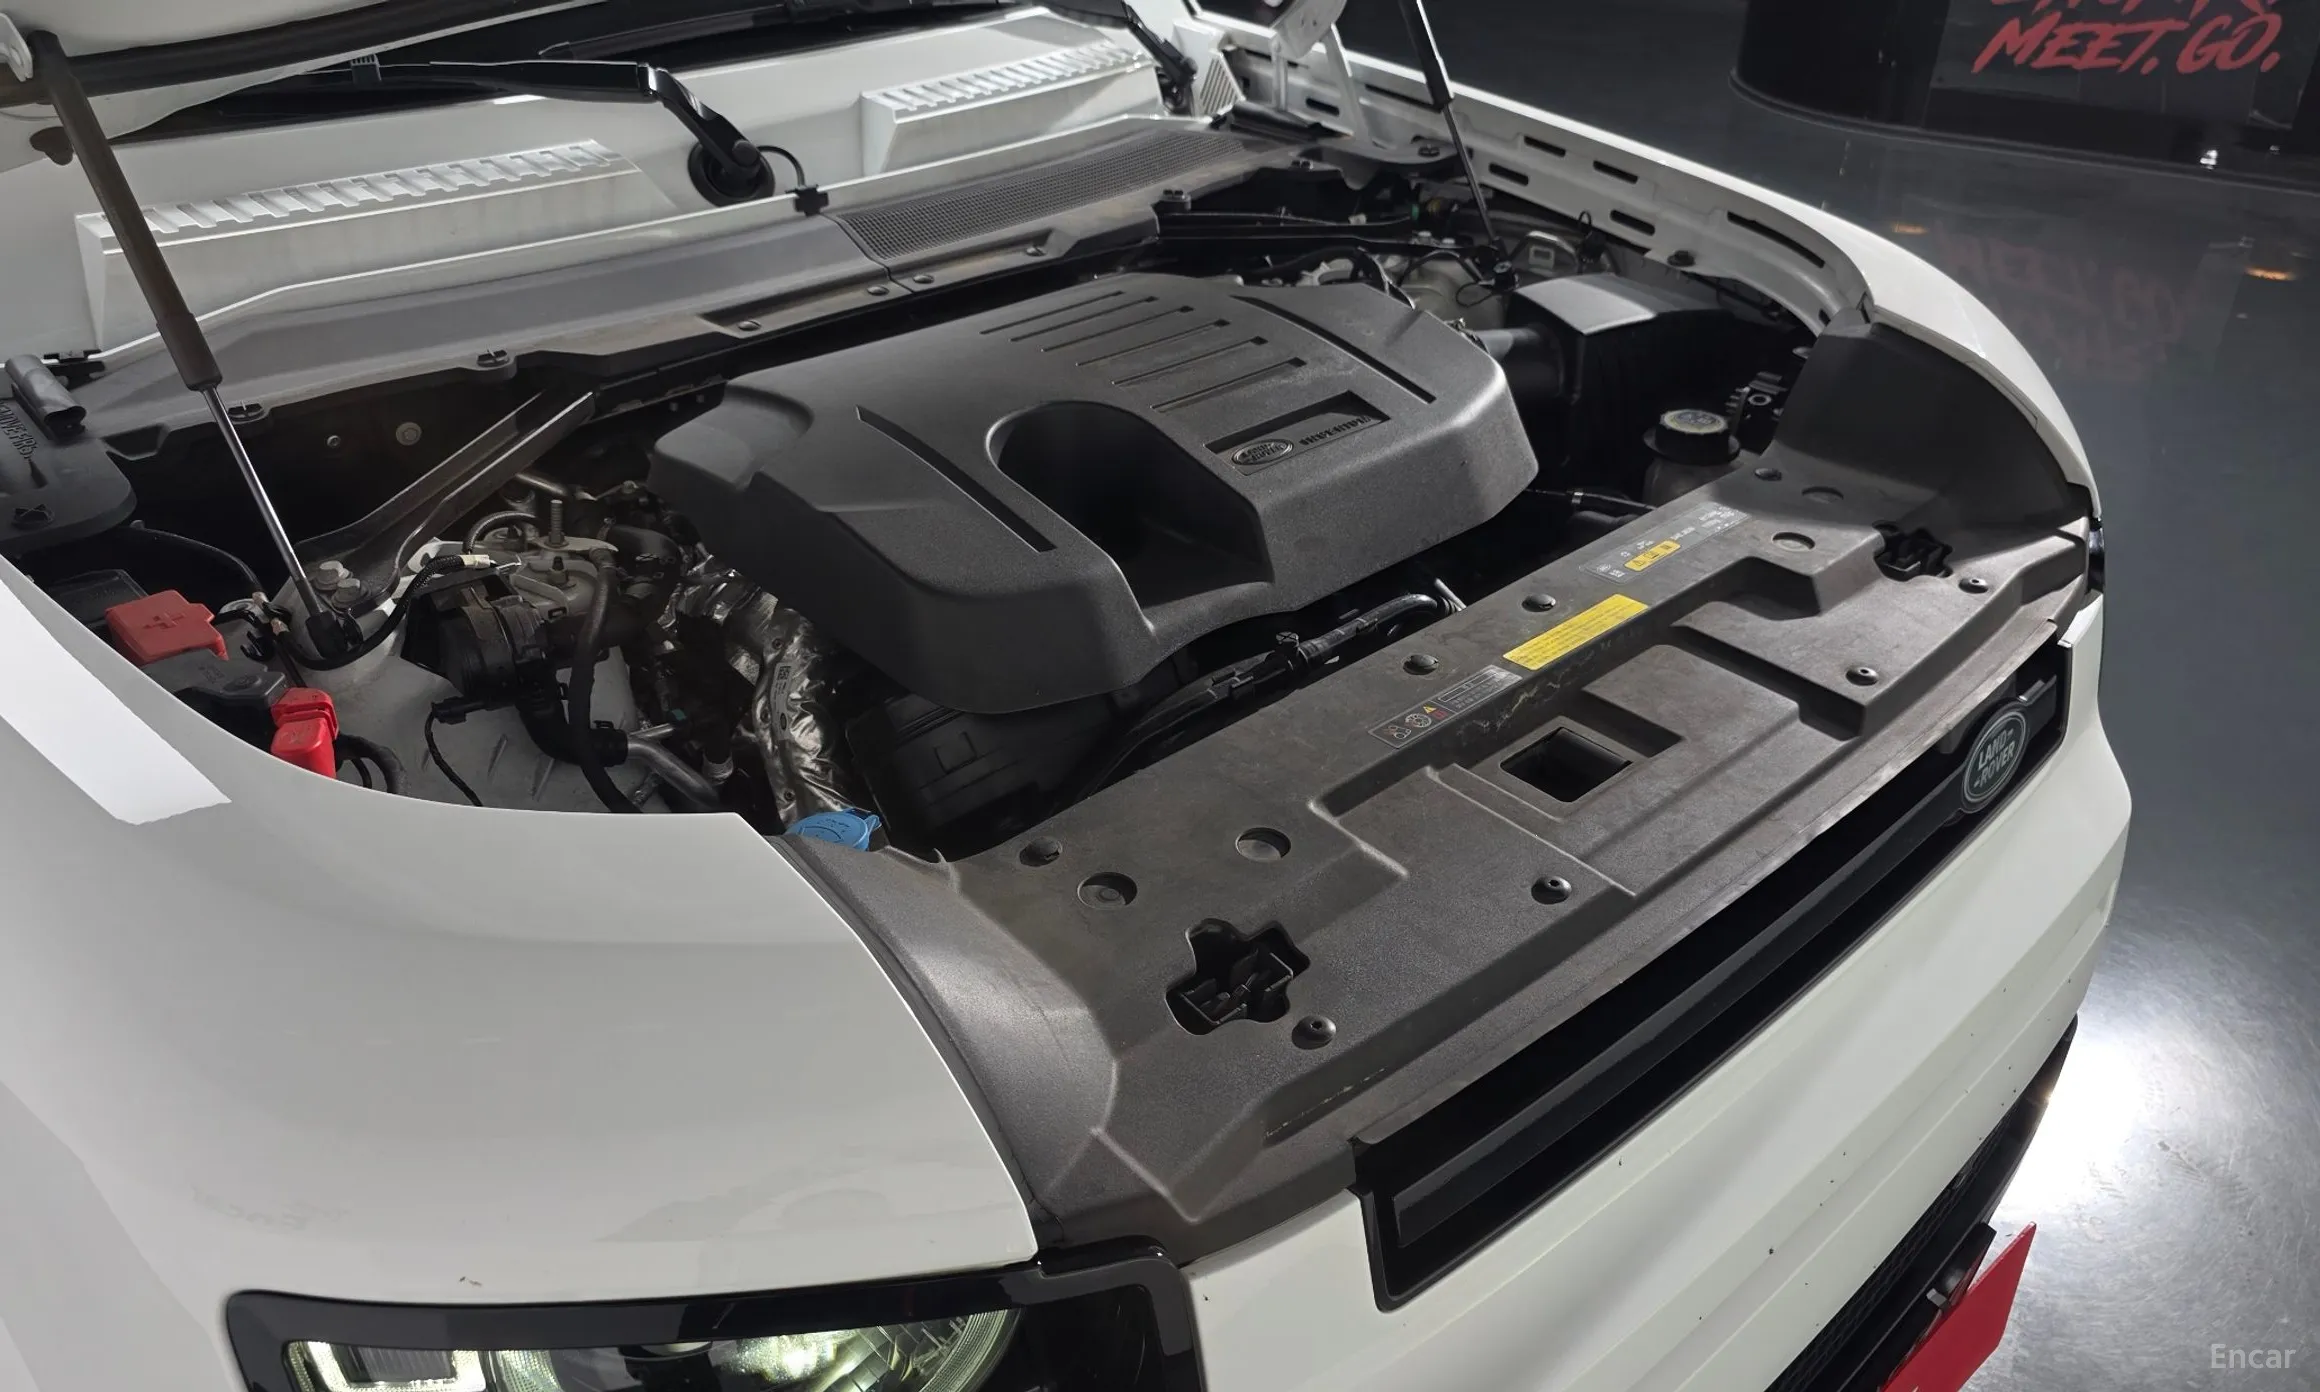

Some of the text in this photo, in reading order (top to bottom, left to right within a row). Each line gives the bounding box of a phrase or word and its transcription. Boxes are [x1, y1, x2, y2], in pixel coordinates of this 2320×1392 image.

[1971, 11, 2282, 75] MEET. GO.
[1978, 729, 2008, 771] LAND
[1979, 741, 2015, 788] ROVER
